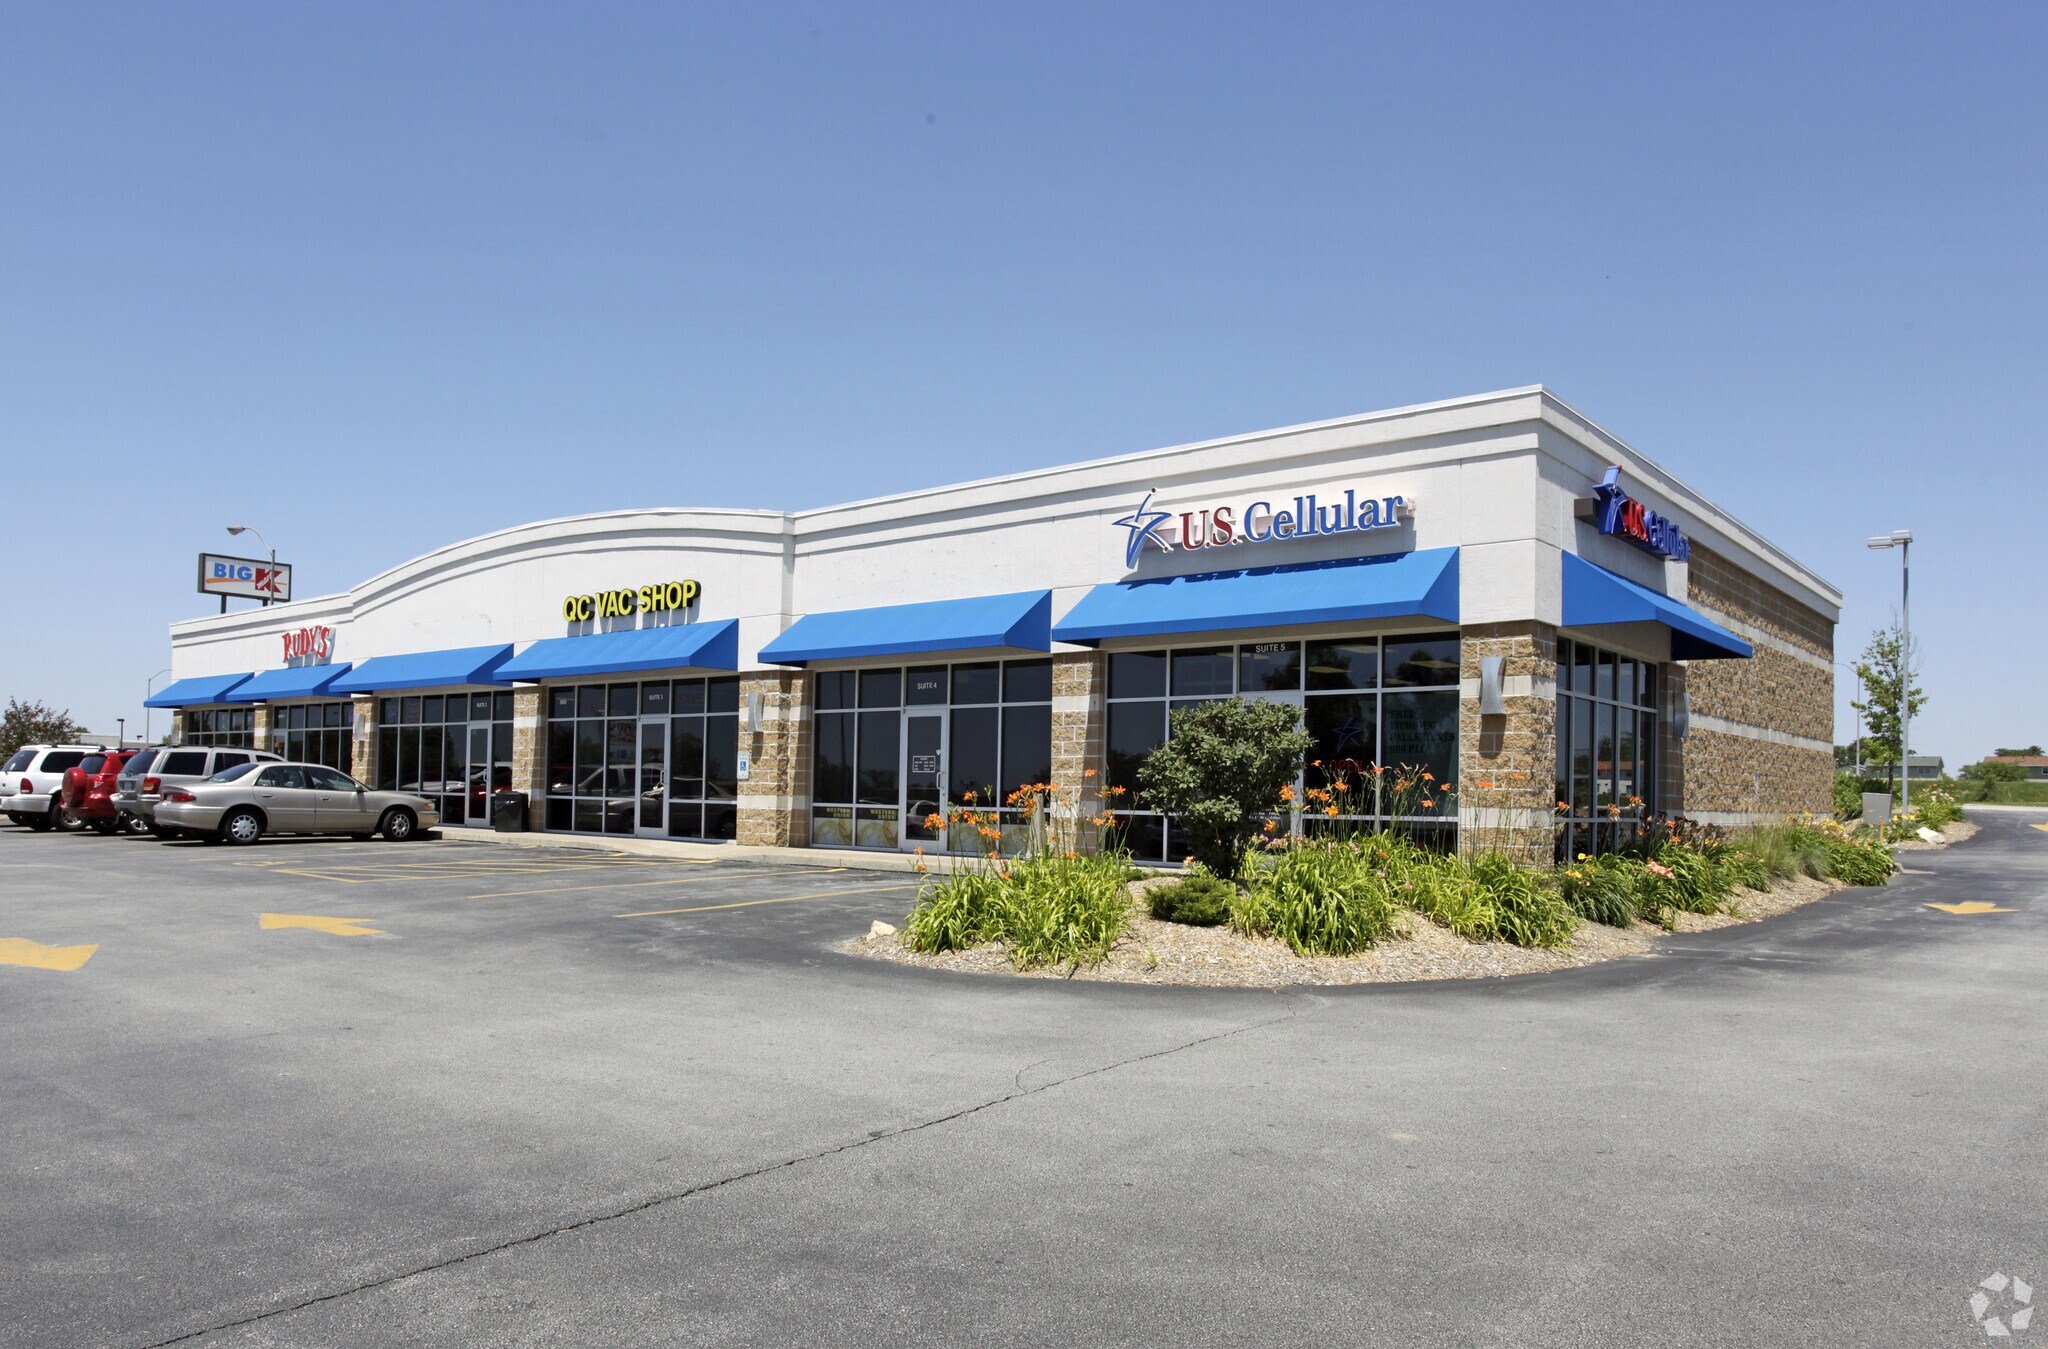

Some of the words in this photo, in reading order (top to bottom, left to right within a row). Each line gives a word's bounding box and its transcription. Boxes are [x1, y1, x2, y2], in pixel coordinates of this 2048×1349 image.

[1179, 506, 1238, 550] U.S.
[1244, 489, 1403, 543] Cellular
[214, 563, 252, 581] BIG
[255, 568, 283, 593] K
[563, 594, 592, 622] QC
[596, 587, 634, 618] VAC
[638, 579, 699, 614] SHOP
[281, 625, 330, 663] RUDY'S
[1255, 643, 1279, 653] SUITE
[1280, 642, 1286, 651] 5
[916, 681, 933, 690] SUITE
[933, 681, 938, 689] 4
[1390, 709, 1415, 719] FREE
[1390, 720, 1436, 730] INCONG
[1423, 732, 1455, 741] TXTS
[1329, 759, 1364, 775] OPEN
